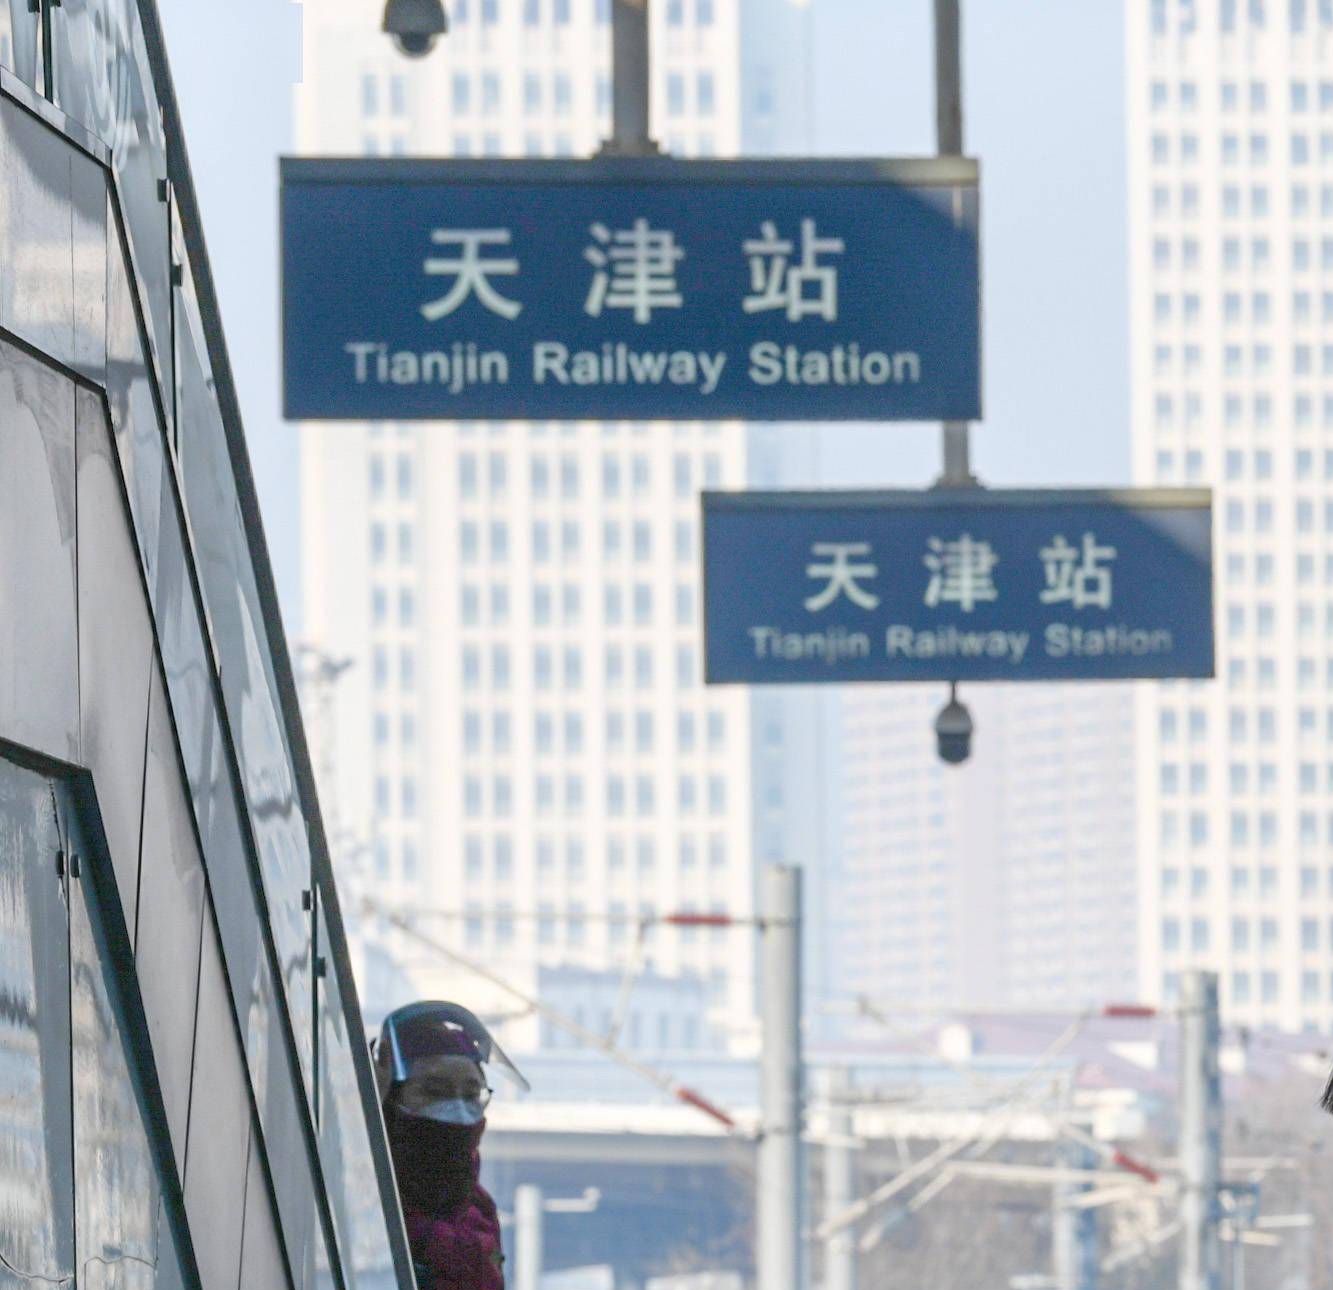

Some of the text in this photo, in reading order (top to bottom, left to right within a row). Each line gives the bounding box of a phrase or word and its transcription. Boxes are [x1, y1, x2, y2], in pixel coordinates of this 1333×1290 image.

[420, 218, 845, 324] 天津站
[346, 341, 920, 395] Tianjin Railway Station
[804, 533, 1117, 612] 天津站
[748, 624, 1172, 663] Tianjin Railway Station
